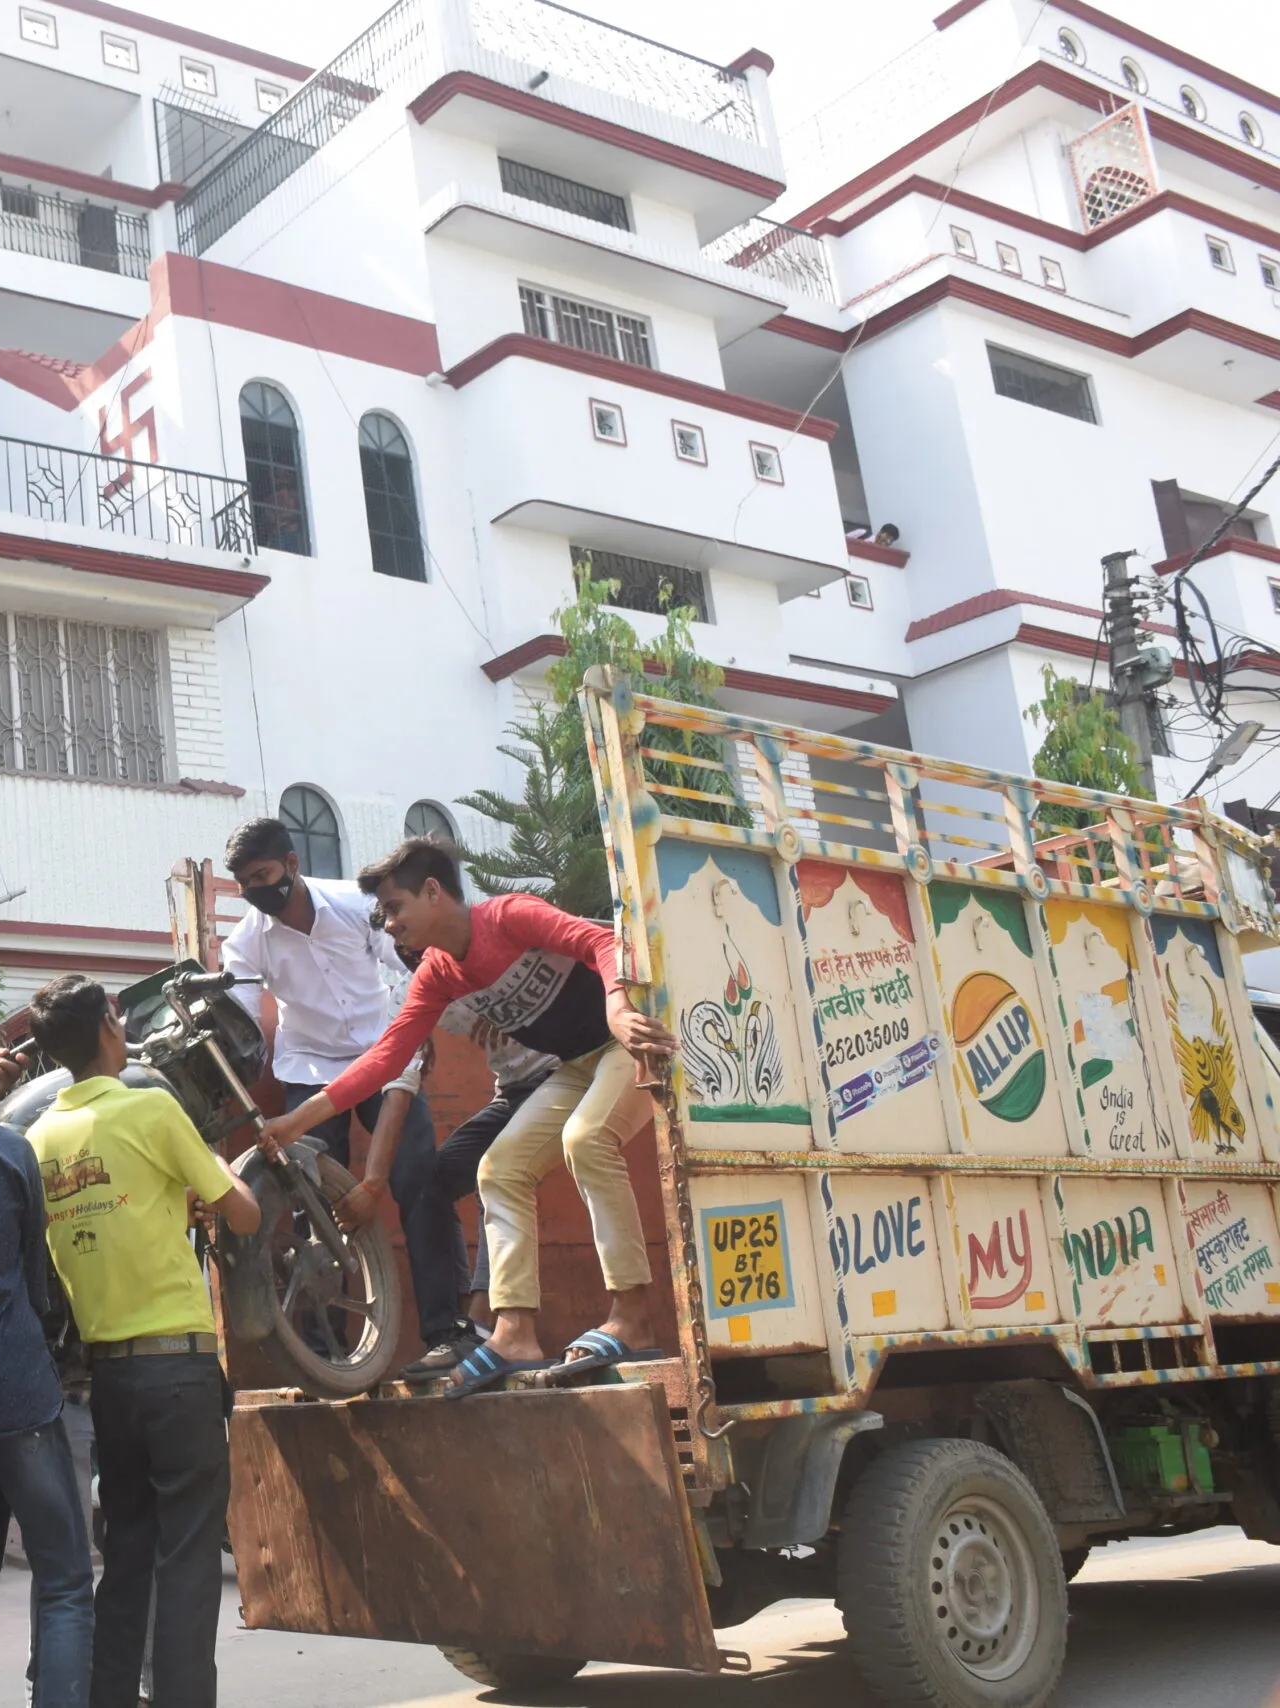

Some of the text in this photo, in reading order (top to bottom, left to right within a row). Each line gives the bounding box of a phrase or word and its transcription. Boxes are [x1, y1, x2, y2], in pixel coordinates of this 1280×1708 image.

[825, 1017, 909, 1067] 252035009
[852, 1196, 925, 1274] LOVE
[1070, 1206, 1154, 1285] NDIA
[735, 1251, 762, 1273] BT
[719, 1271, 780, 1307] 9716
